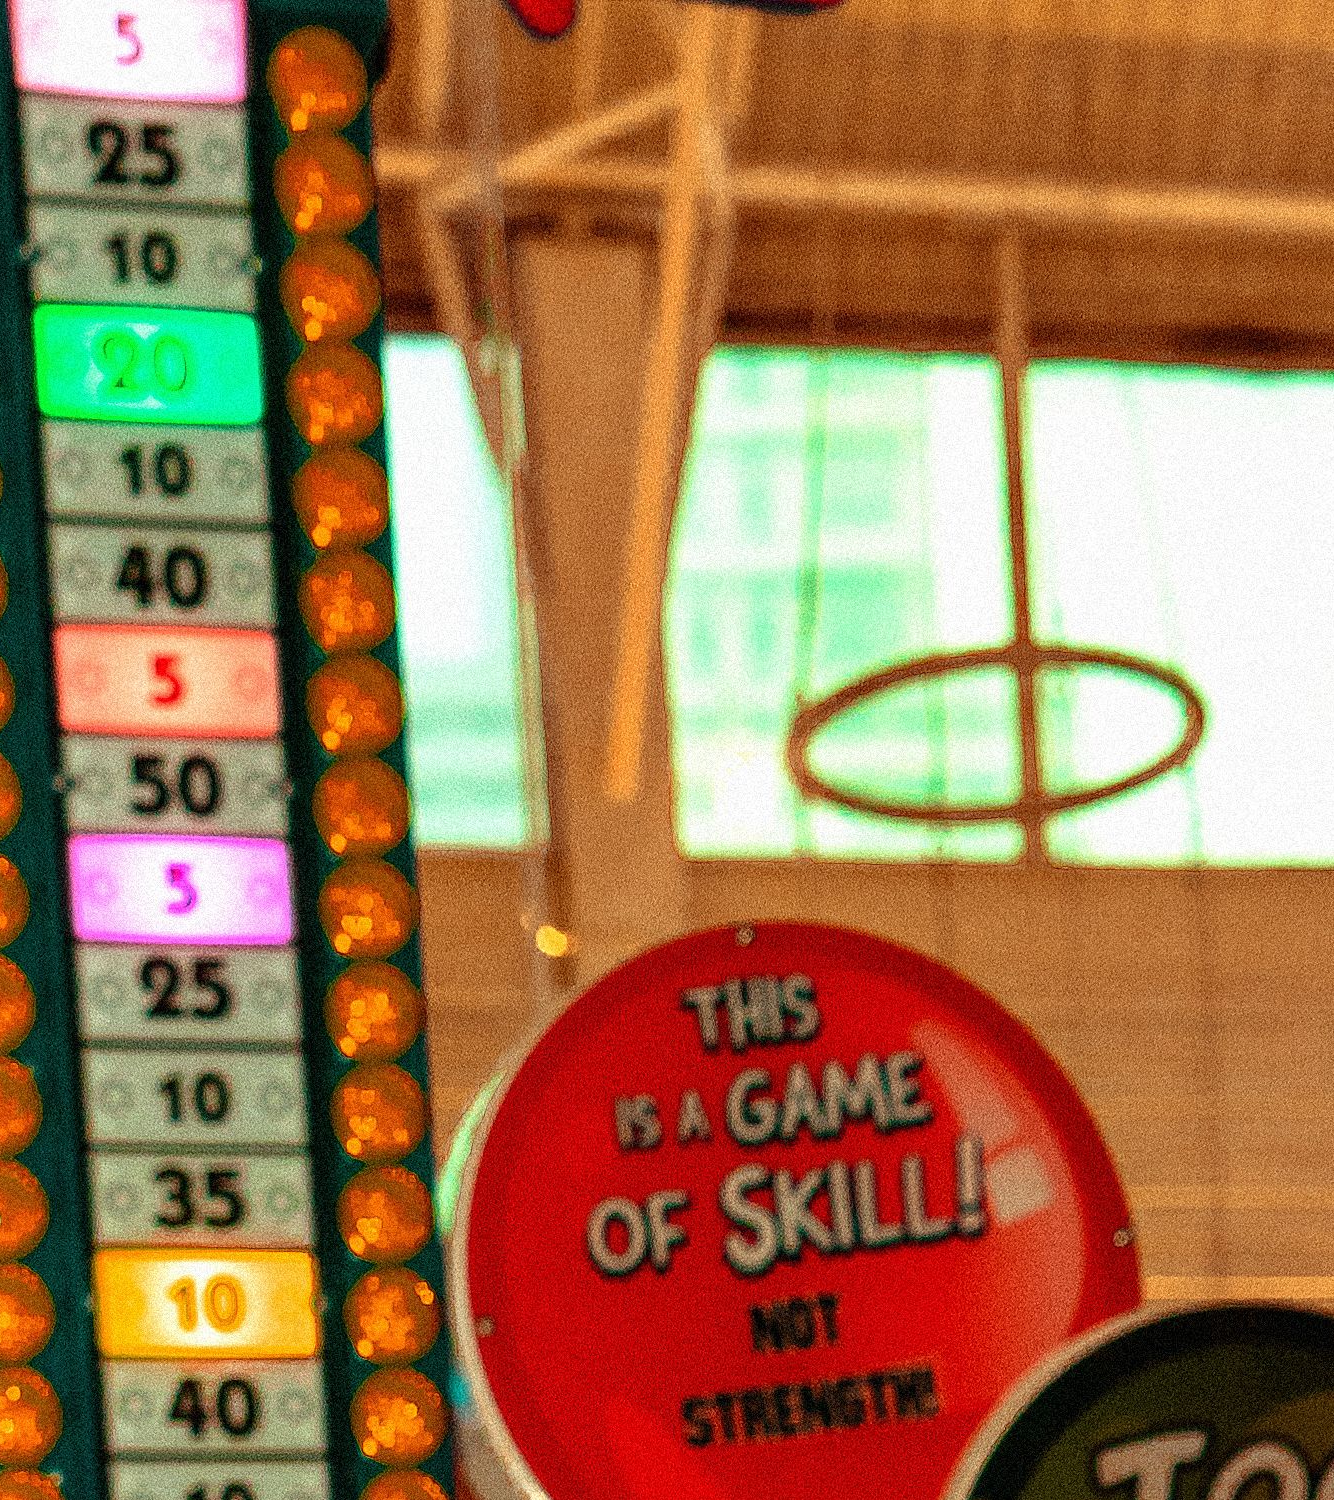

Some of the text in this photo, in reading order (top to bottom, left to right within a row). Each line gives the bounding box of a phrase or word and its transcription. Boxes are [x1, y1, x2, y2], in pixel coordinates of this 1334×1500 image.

[113, 11, 142, 66] 5
[85, 119, 183, 187] 25
[105, 229, 178, 285] 10
[101, 328, 189, 393] 20
[118, 443, 193, 498] 10
[116, 545, 208, 609] 40
[148, 656, 185, 706] 5
[129, 753, 220, 816] 50
[165, 862, 199, 915] 5
[139, 957, 231, 1021] 25
[679, 970, 822, 1052] THIS
[158, 1072, 231, 1123] 10
[614, 1051, 934, 1152] IS A GAME
[155, 1168, 246, 1229] 35
[586, 1134, 987, 1277] OF SKILL!
[166, 1276, 245, 1334] 10
[749, 1294, 840, 1352] NOT
[166, 1376, 257, 1438] 40
